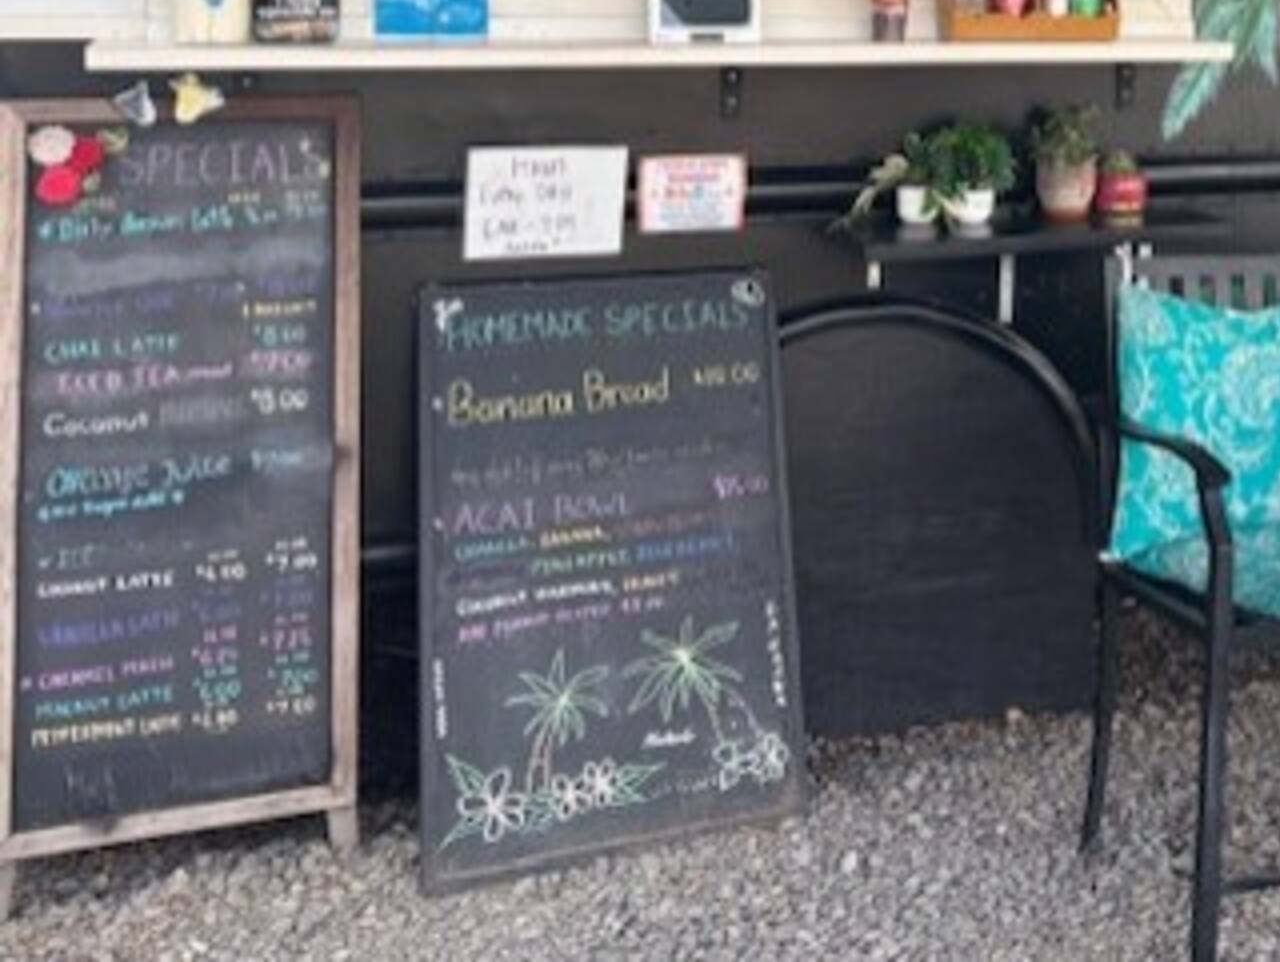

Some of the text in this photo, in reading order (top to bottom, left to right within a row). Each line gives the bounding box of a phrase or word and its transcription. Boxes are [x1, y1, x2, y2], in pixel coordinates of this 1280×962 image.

[604, 299, 749, 337] SPECIALS
[134, 364, 180, 388] TEA
[449, 378, 574, 427] Banana
[583, 367, 669, 414] Bread
[43, 410, 149, 437] Coconut
[454, 497, 535, 535] ACAI
[554, 493, 631, 524] BOWL
[116, 569, 174, 590] LATTE
